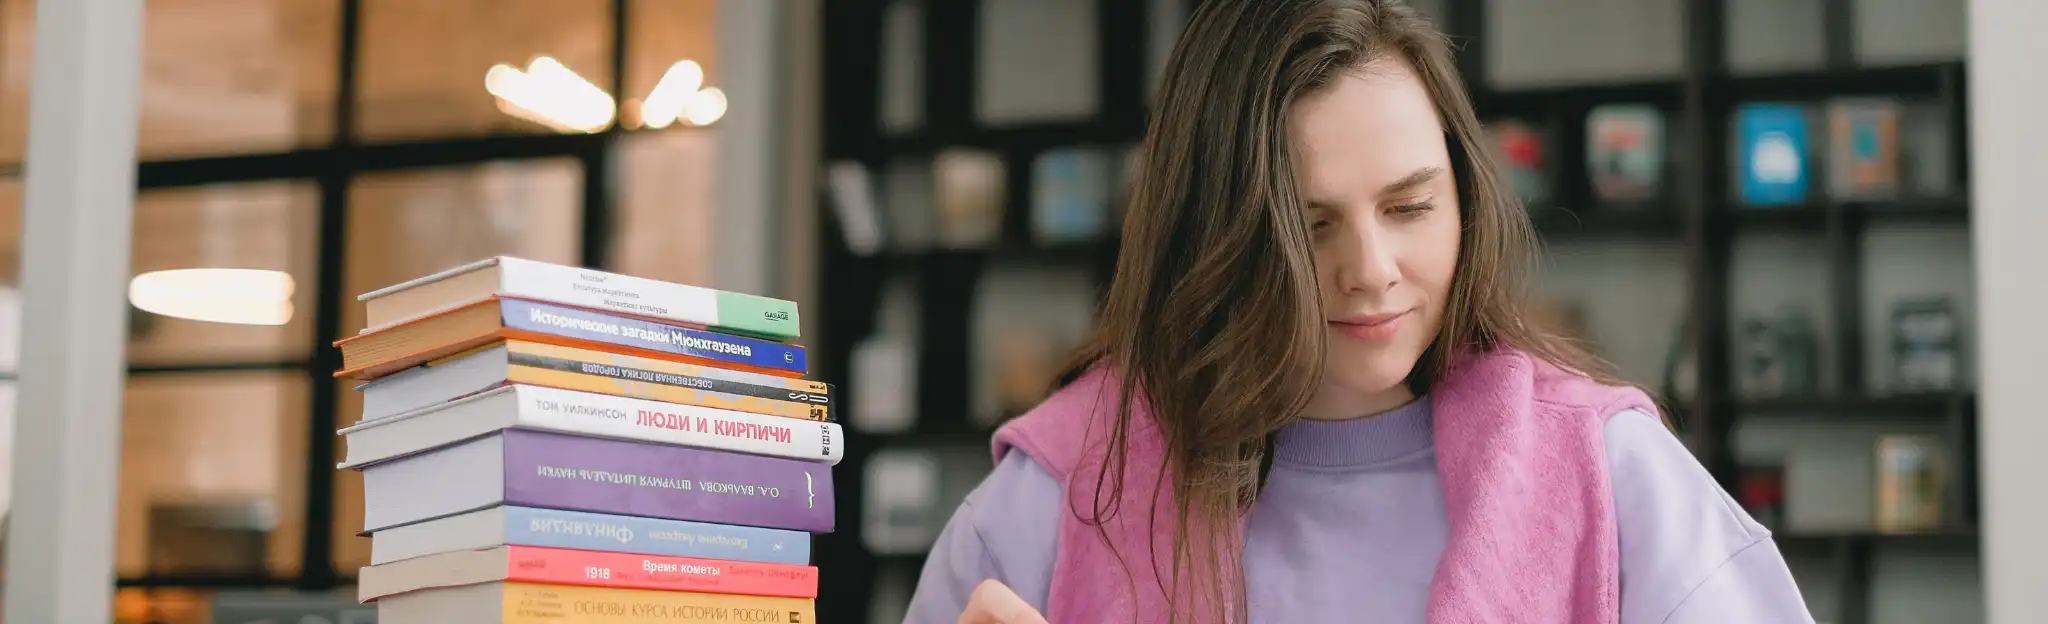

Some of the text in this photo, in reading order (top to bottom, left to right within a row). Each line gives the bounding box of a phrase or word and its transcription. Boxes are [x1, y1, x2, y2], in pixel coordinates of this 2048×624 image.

[764, 311, 789, 321] GARAGE
[530, 307, 752, 357] Исторические загадки Мюнхгаузена
[582, 363, 713, 389] СОБСТВЕННАЯ ЛОГИКА ГОРОДОВ
[536, 399, 791, 444] ТОМ УИЛКИНСОН ЛЮДИ И КИРПИЧИ
[537, 465, 576, 479] НАУКИ
[579, 469, 636, 486] ЦИТАДЕЛЬ
[639, 475, 692, 490] ШТУРМУЯ
[699, 480, 754, 495] ВАЛЬКОВА
[584, 567, 611, 580] 1918
[643, 559, 677, 574] Время
[681, 564, 720, 576] кометы
[574, 600, 626, 617] ОСНОВЫ
[632, 603, 668, 618] КУРСА
[673, 605, 728, 621] ИСТОРИИ
[734, 608, 780, 623] РОССИИ
